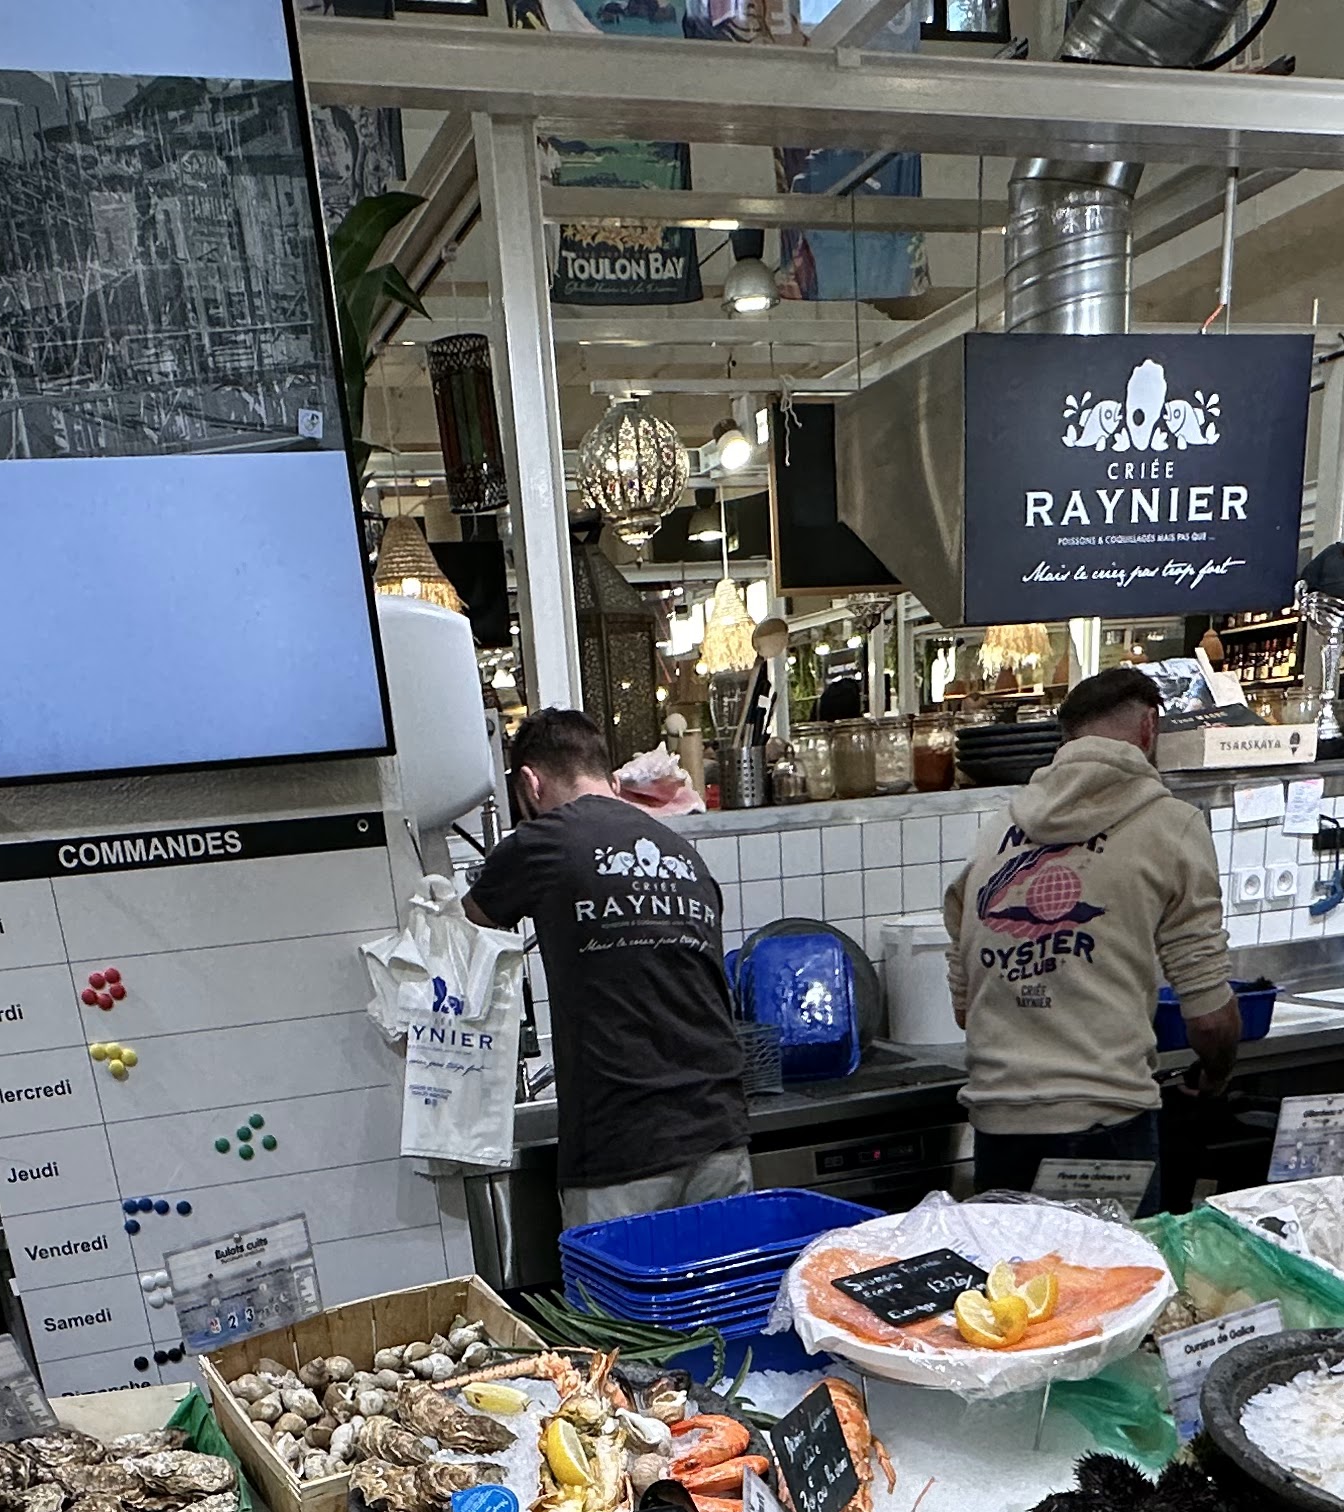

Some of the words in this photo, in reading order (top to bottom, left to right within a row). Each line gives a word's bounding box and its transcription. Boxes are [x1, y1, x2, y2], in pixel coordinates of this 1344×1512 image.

[561, 250, 647, 280] TOULON
[649, 252, 685, 279] BAY
[1107, 458, 1175, 480] CRIÉE
[1025, 485, 1249, 527] RAYNIER
[1022, 561, 1067, 583] Mais
[1074, 565, 1088, 581] le
[1123, 563, 1158, 587] pas
[1162, 559, 1195, 585] trop
[1190, 557, 1247, 589] fort
[1220, 740, 1281, 751] TSARSKAYA
[58, 830, 243, 869] COMMANDES
[575, 895, 715, 928] RAYNIER
[980, 930, 1095, 970] OYSTER
[1007, 957, 1057, 982] CLUB
[412, 1025, 493, 1050] YNIER
[7, 1162, 60, 1184] Jeudi
[24, 1235, 109, 1261] Vendredi
[246, 1237, 268, 1250] cuits
[43, 1308, 112, 1333] Samedi
[1184, 1338, 1216, 1355] Oursins
[1217, 1332, 1228, 1344] de
[1229, 1324, 1256, 1339] Galice
